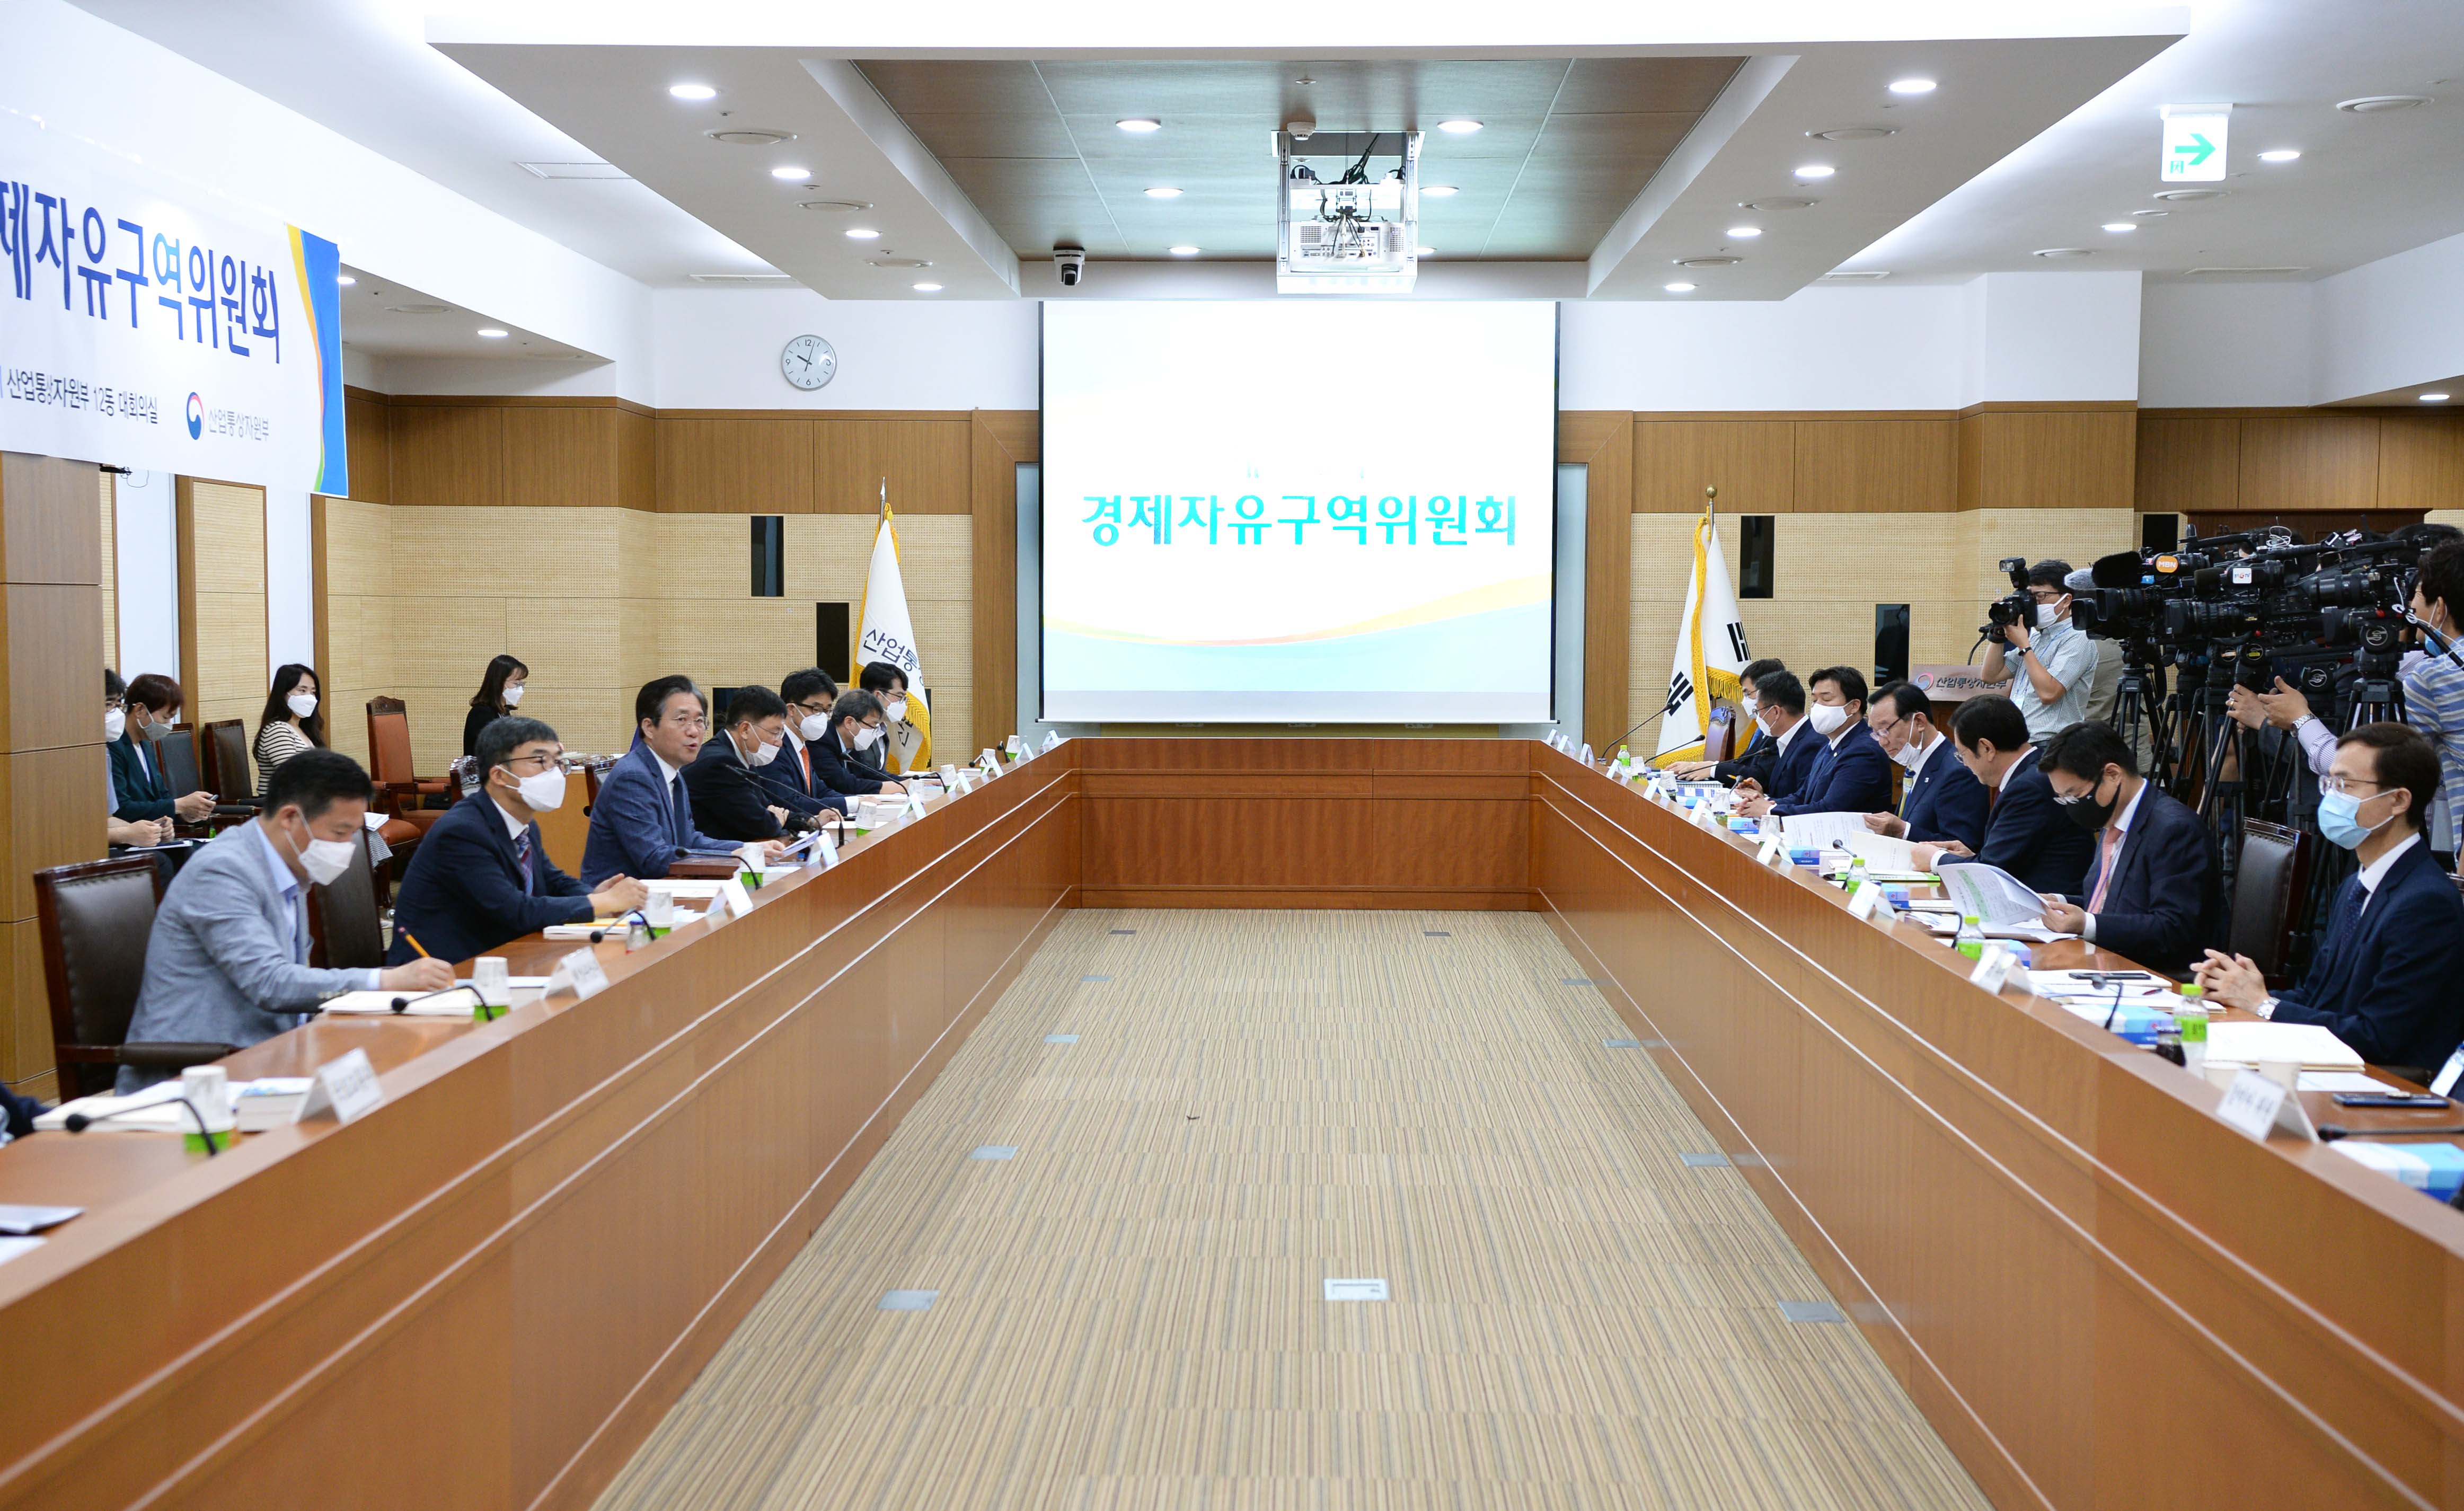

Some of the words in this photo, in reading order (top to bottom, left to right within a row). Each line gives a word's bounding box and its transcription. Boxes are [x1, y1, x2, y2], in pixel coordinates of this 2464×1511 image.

[0, 181, 280, 364] 제자유구역위원회
[7, 368, 89, 411] 산업통상자원부
[94, 387, 114, 417] 12동
[118, 391, 158, 424] 대회의실
[209, 409, 269, 441] 산업통상자원부
[1082, 494, 1516, 546] 경제자유구역위원회
[863, 629, 923, 686] 산업통
